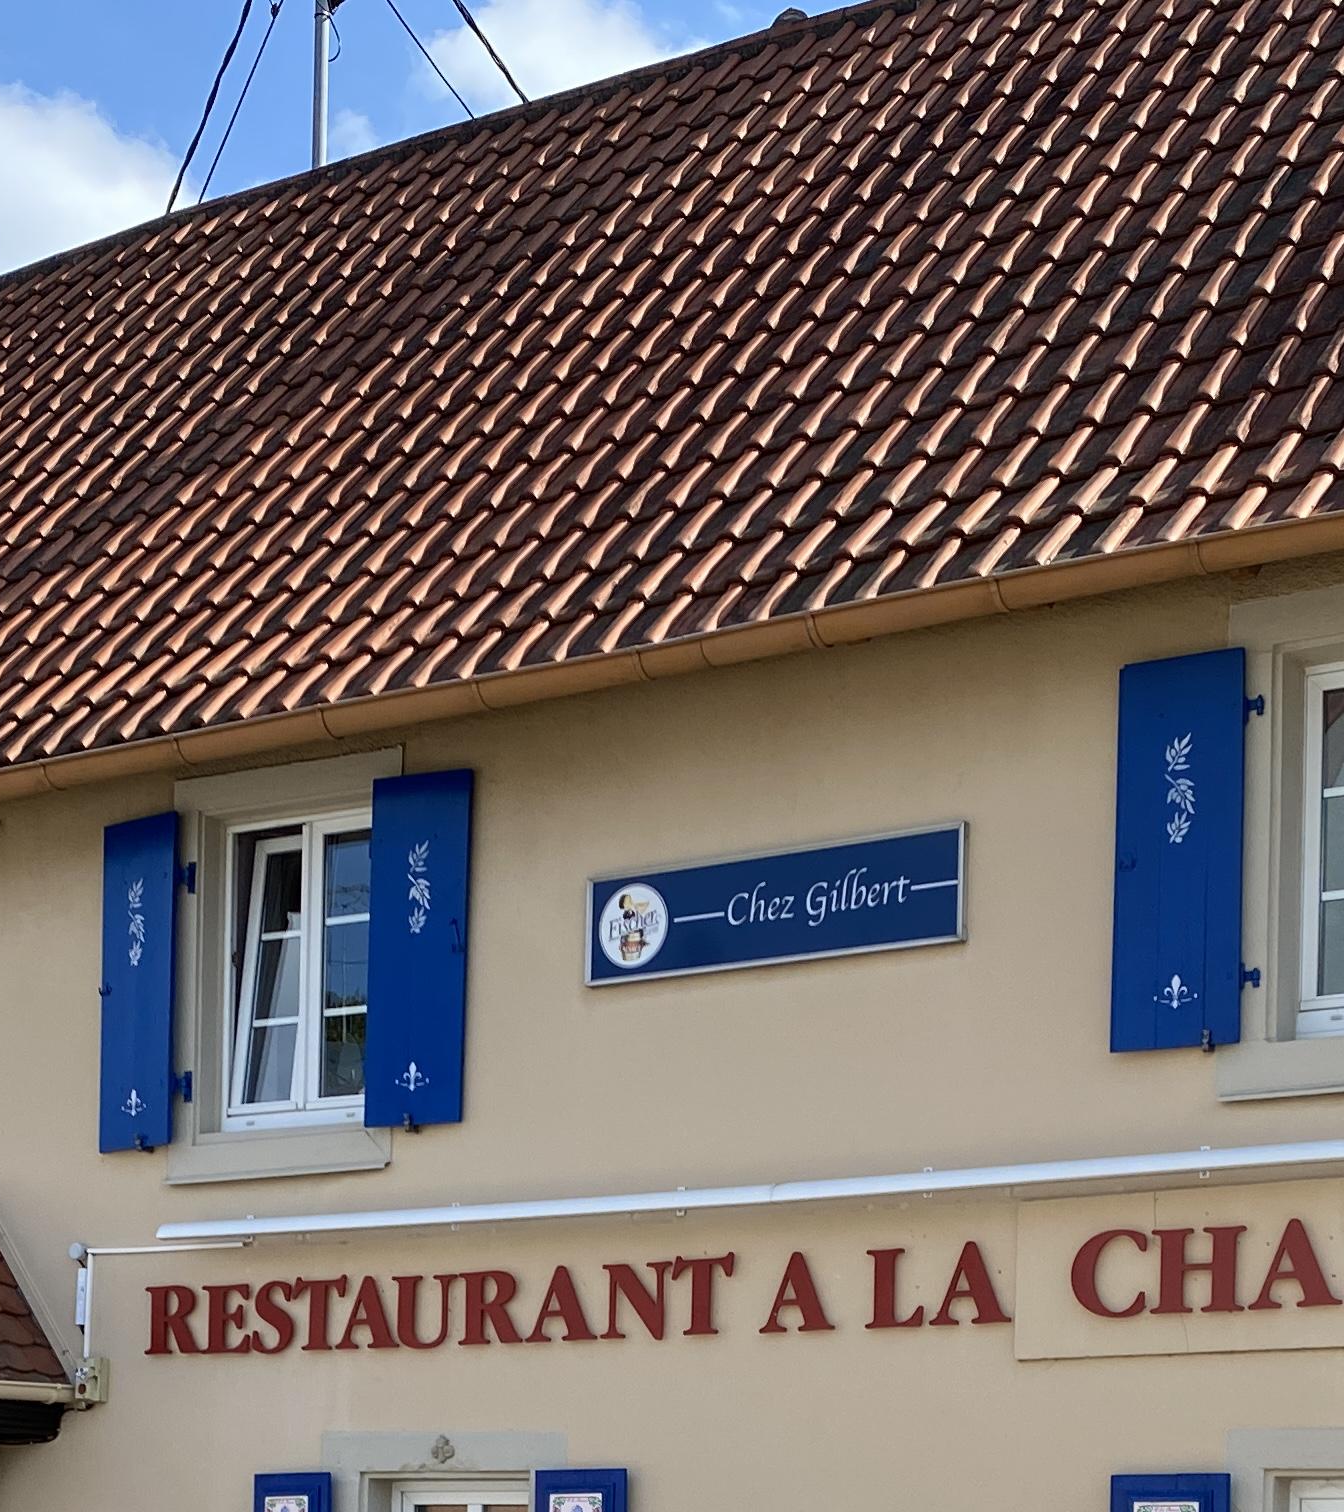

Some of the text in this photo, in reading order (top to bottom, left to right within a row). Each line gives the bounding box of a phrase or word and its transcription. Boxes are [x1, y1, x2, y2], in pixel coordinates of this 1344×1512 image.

[609, 910, 658, 941] Fischer
[727, 867, 911, 926] Chez Gilbert
[144, 1251, 736, 1356] RESTAURANT
[758, 1251, 835, 1335] A
[864, 1240, 1012, 1331] LA
